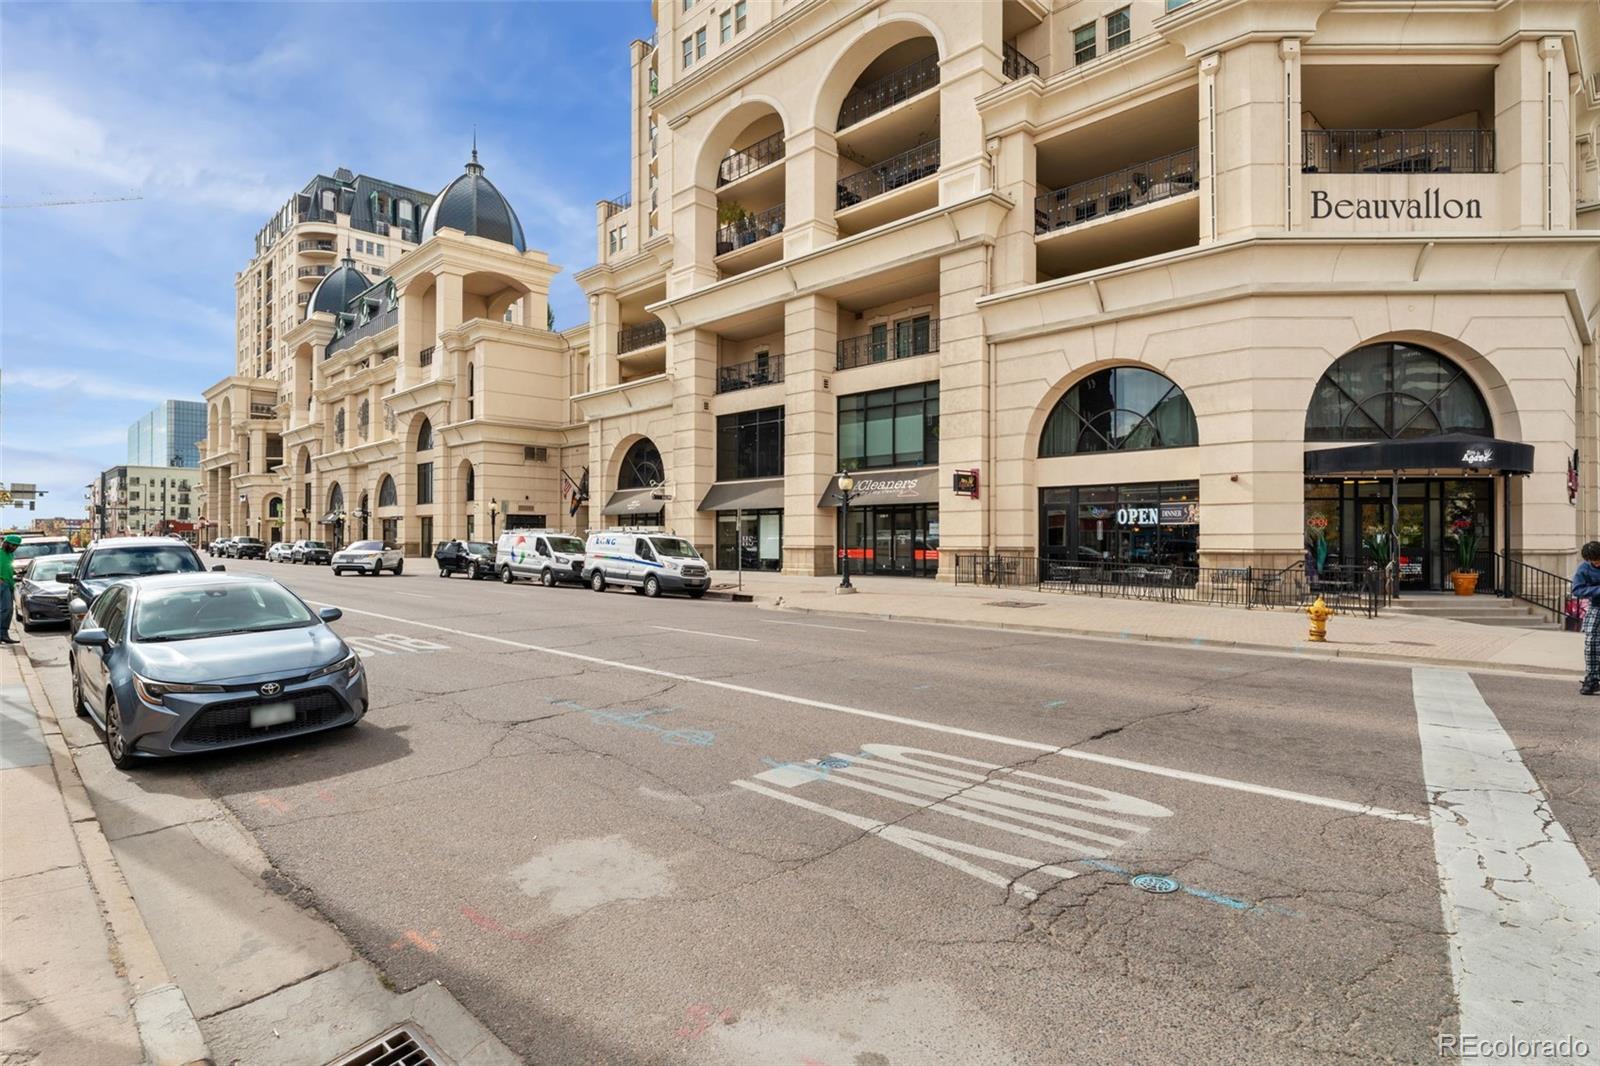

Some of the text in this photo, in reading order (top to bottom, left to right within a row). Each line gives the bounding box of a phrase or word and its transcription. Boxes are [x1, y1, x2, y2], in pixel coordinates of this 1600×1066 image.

[1310, 187, 1482, 219] Beauvallon
[858, 479, 919, 491] Cleaners
[1118, 509, 1159, 525] OPEN
[1162, 509, 1182, 517] DINNER
